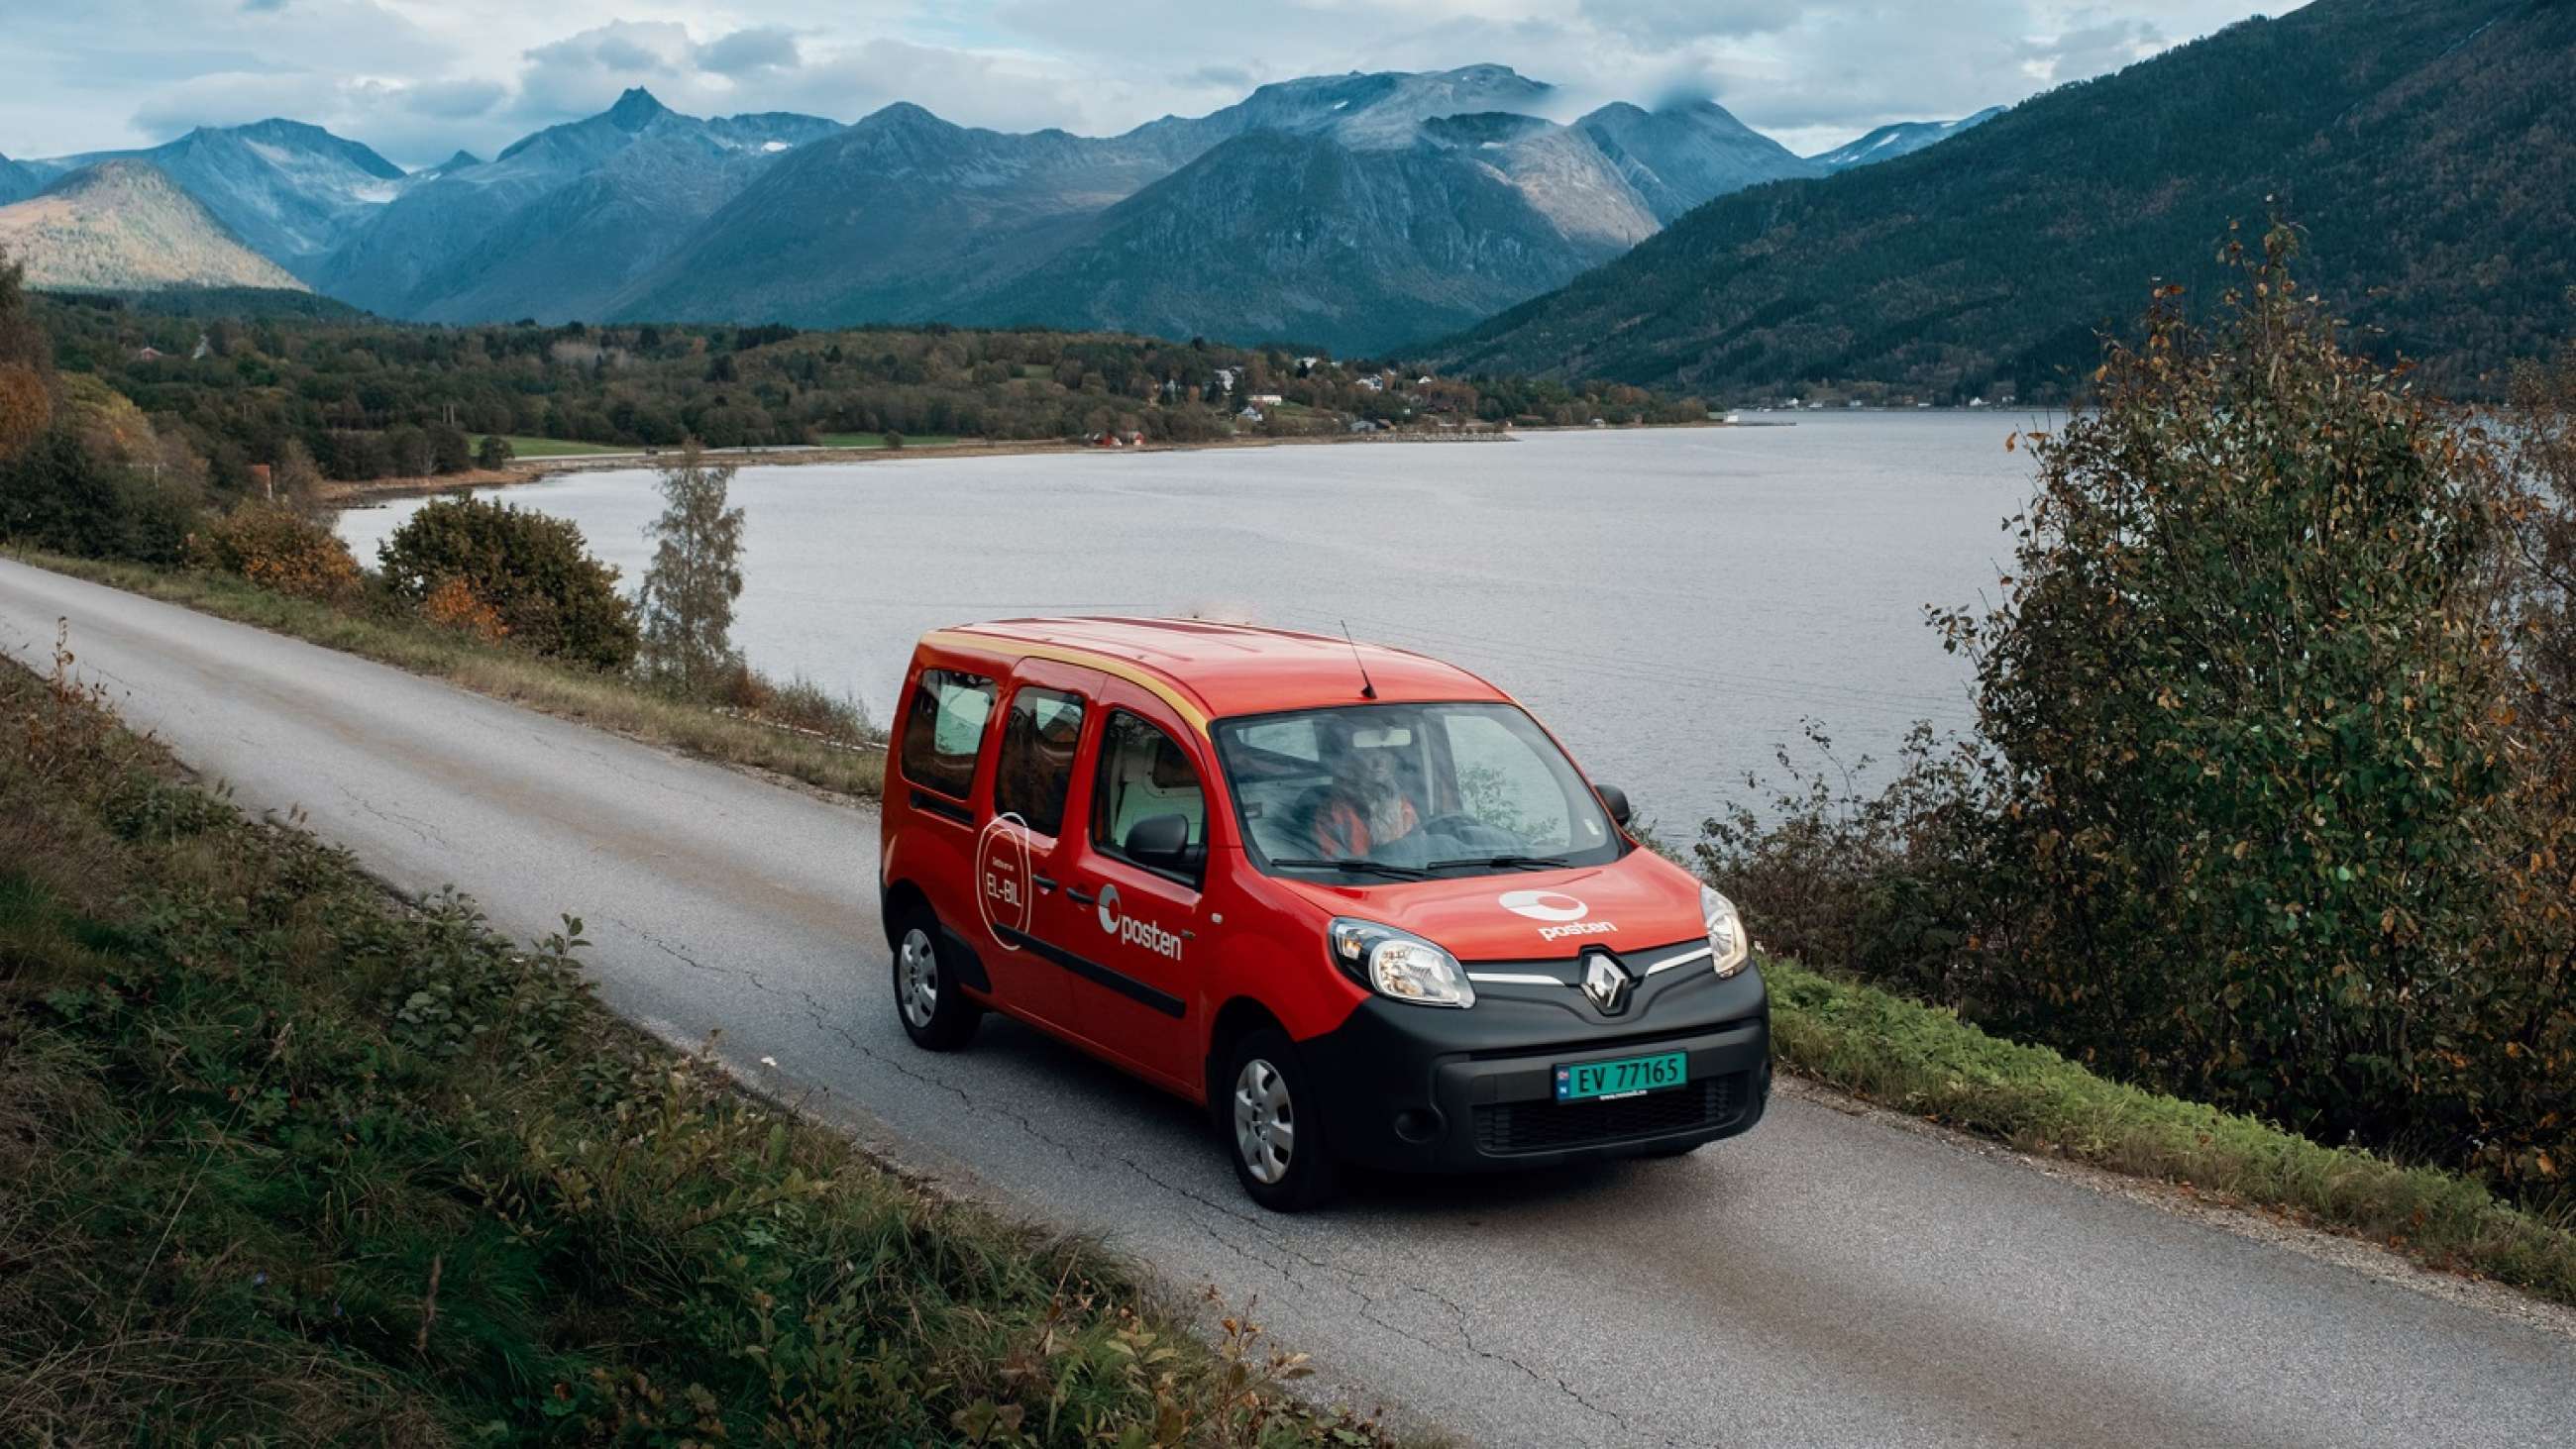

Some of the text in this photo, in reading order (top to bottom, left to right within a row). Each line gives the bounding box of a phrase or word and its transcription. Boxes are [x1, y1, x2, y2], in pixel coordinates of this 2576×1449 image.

[987, 872, 1021, 907] EL-BIL
[1121, 915, 1181, 961] posten
[1538, 921, 1618, 941] posten
[1578, 1058, 1677, 1093] EV 77165
